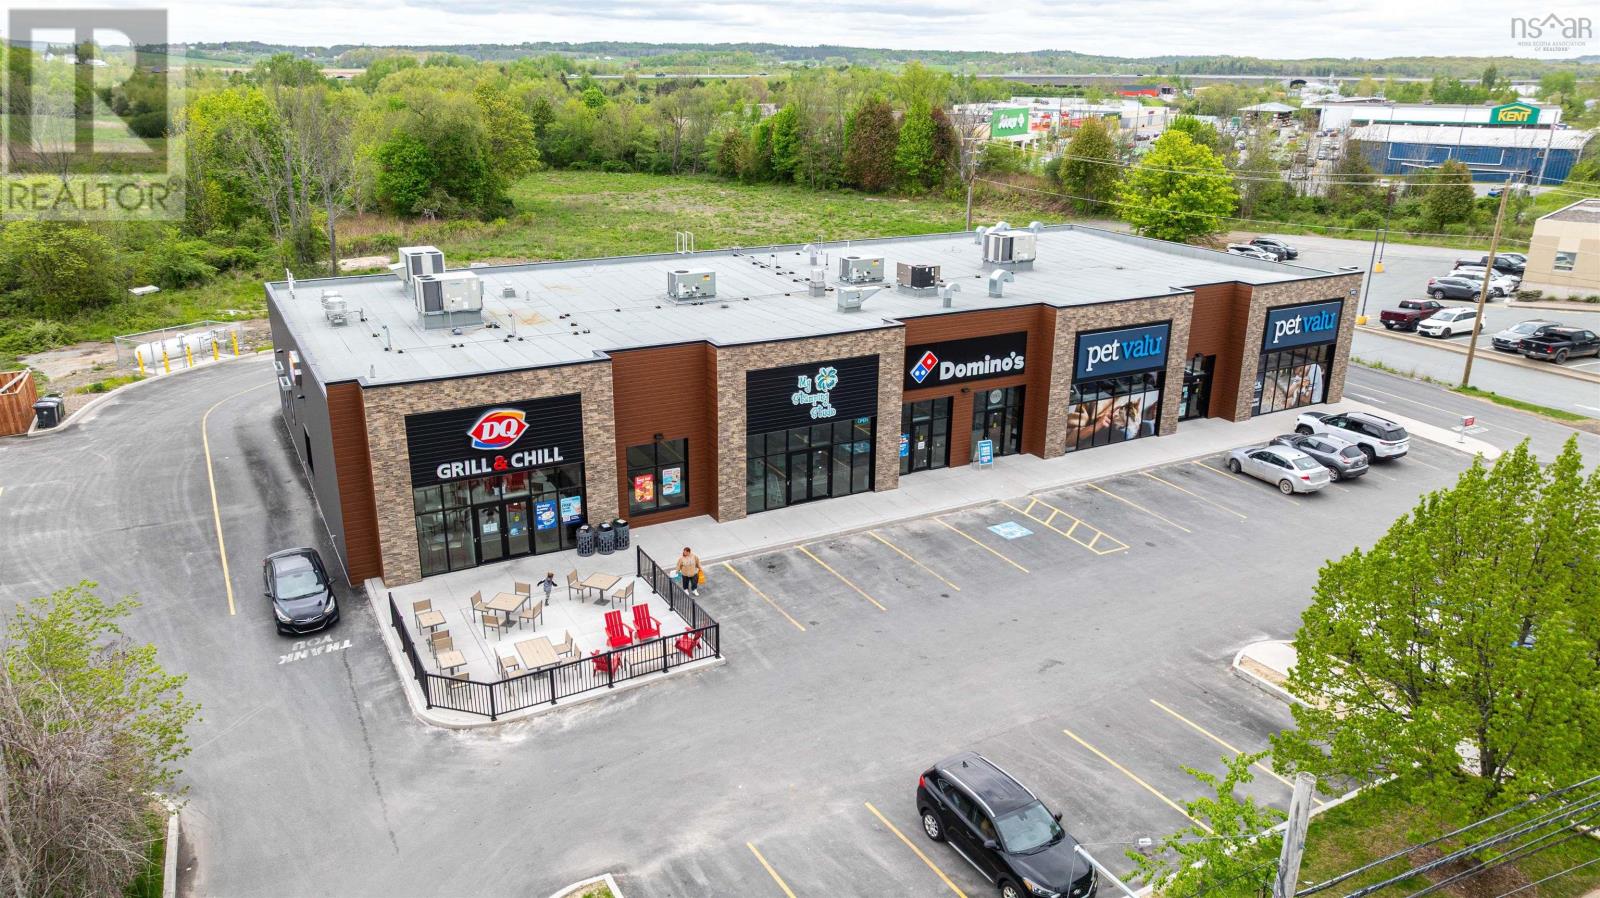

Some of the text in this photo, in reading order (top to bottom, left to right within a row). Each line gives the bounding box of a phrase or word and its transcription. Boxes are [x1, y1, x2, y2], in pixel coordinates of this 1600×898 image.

[1498, 111, 1531, 121] KENT
[1273, 310, 1336, 344] pet valu
[939, 351, 1025, 381] Domino's
[1086, 334, 1161, 372] pet valu
[798, 375, 812, 393] My
[481, 418, 520, 441] DQ
[436, 446, 564, 479] GRILL & CHILL
[278, 639, 353, 665] THANK
[292, 634, 333, 651] YOU
